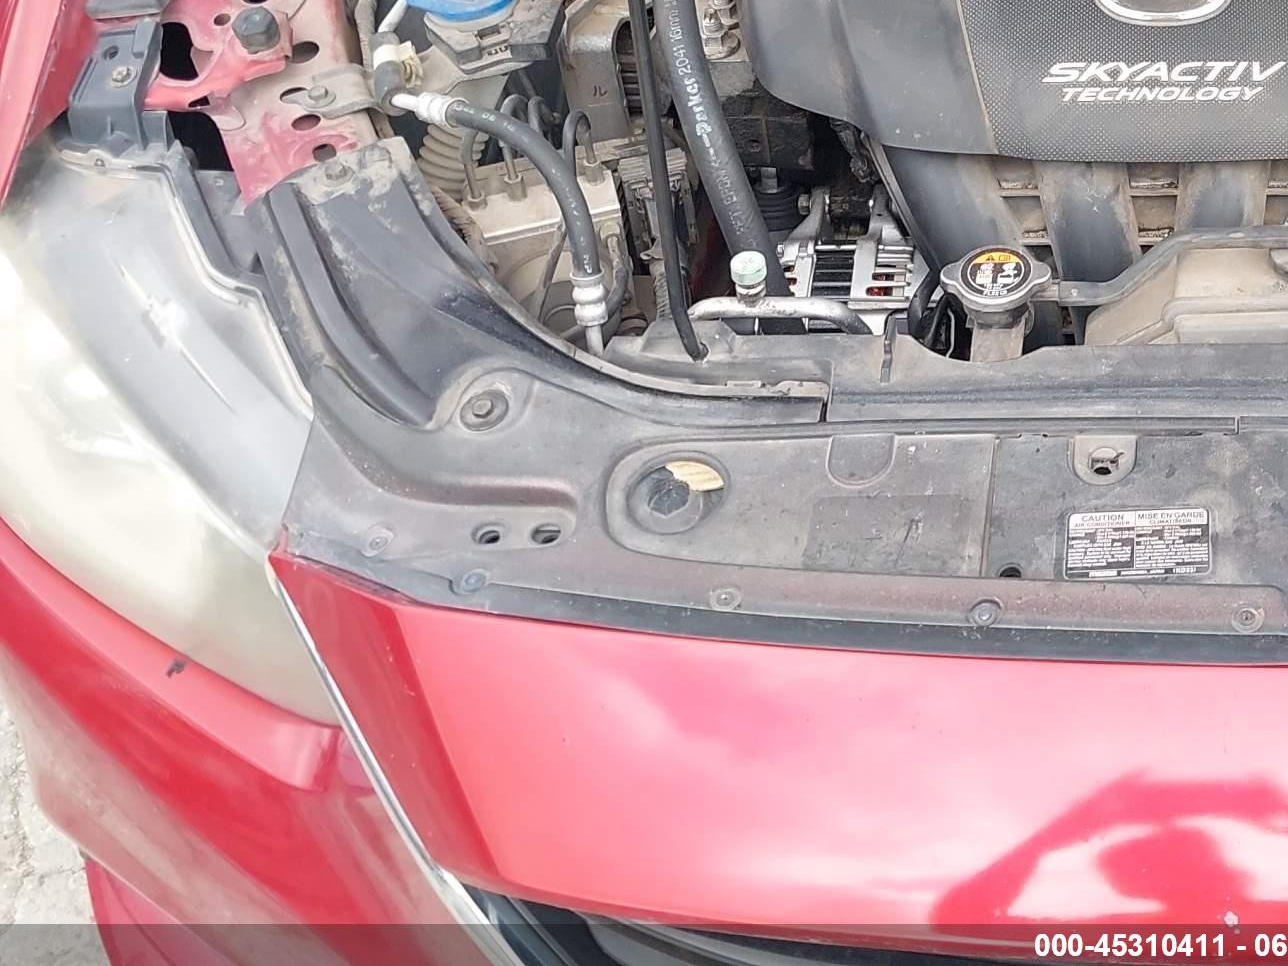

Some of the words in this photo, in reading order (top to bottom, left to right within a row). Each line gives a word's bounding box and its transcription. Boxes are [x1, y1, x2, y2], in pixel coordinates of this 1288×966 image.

[673, 43, 692, 75] 2041
[1042, 61, 1287, 83] SKYACTIV
[1061, 86, 1264, 103] TECHNOLOGY
[682, 76, 713, 137] Parker
[1081, 514, 1125, 522] CAUTION
[1161, 512, 1172, 520] EN
[1174, 511, 1205, 519] GARDE
